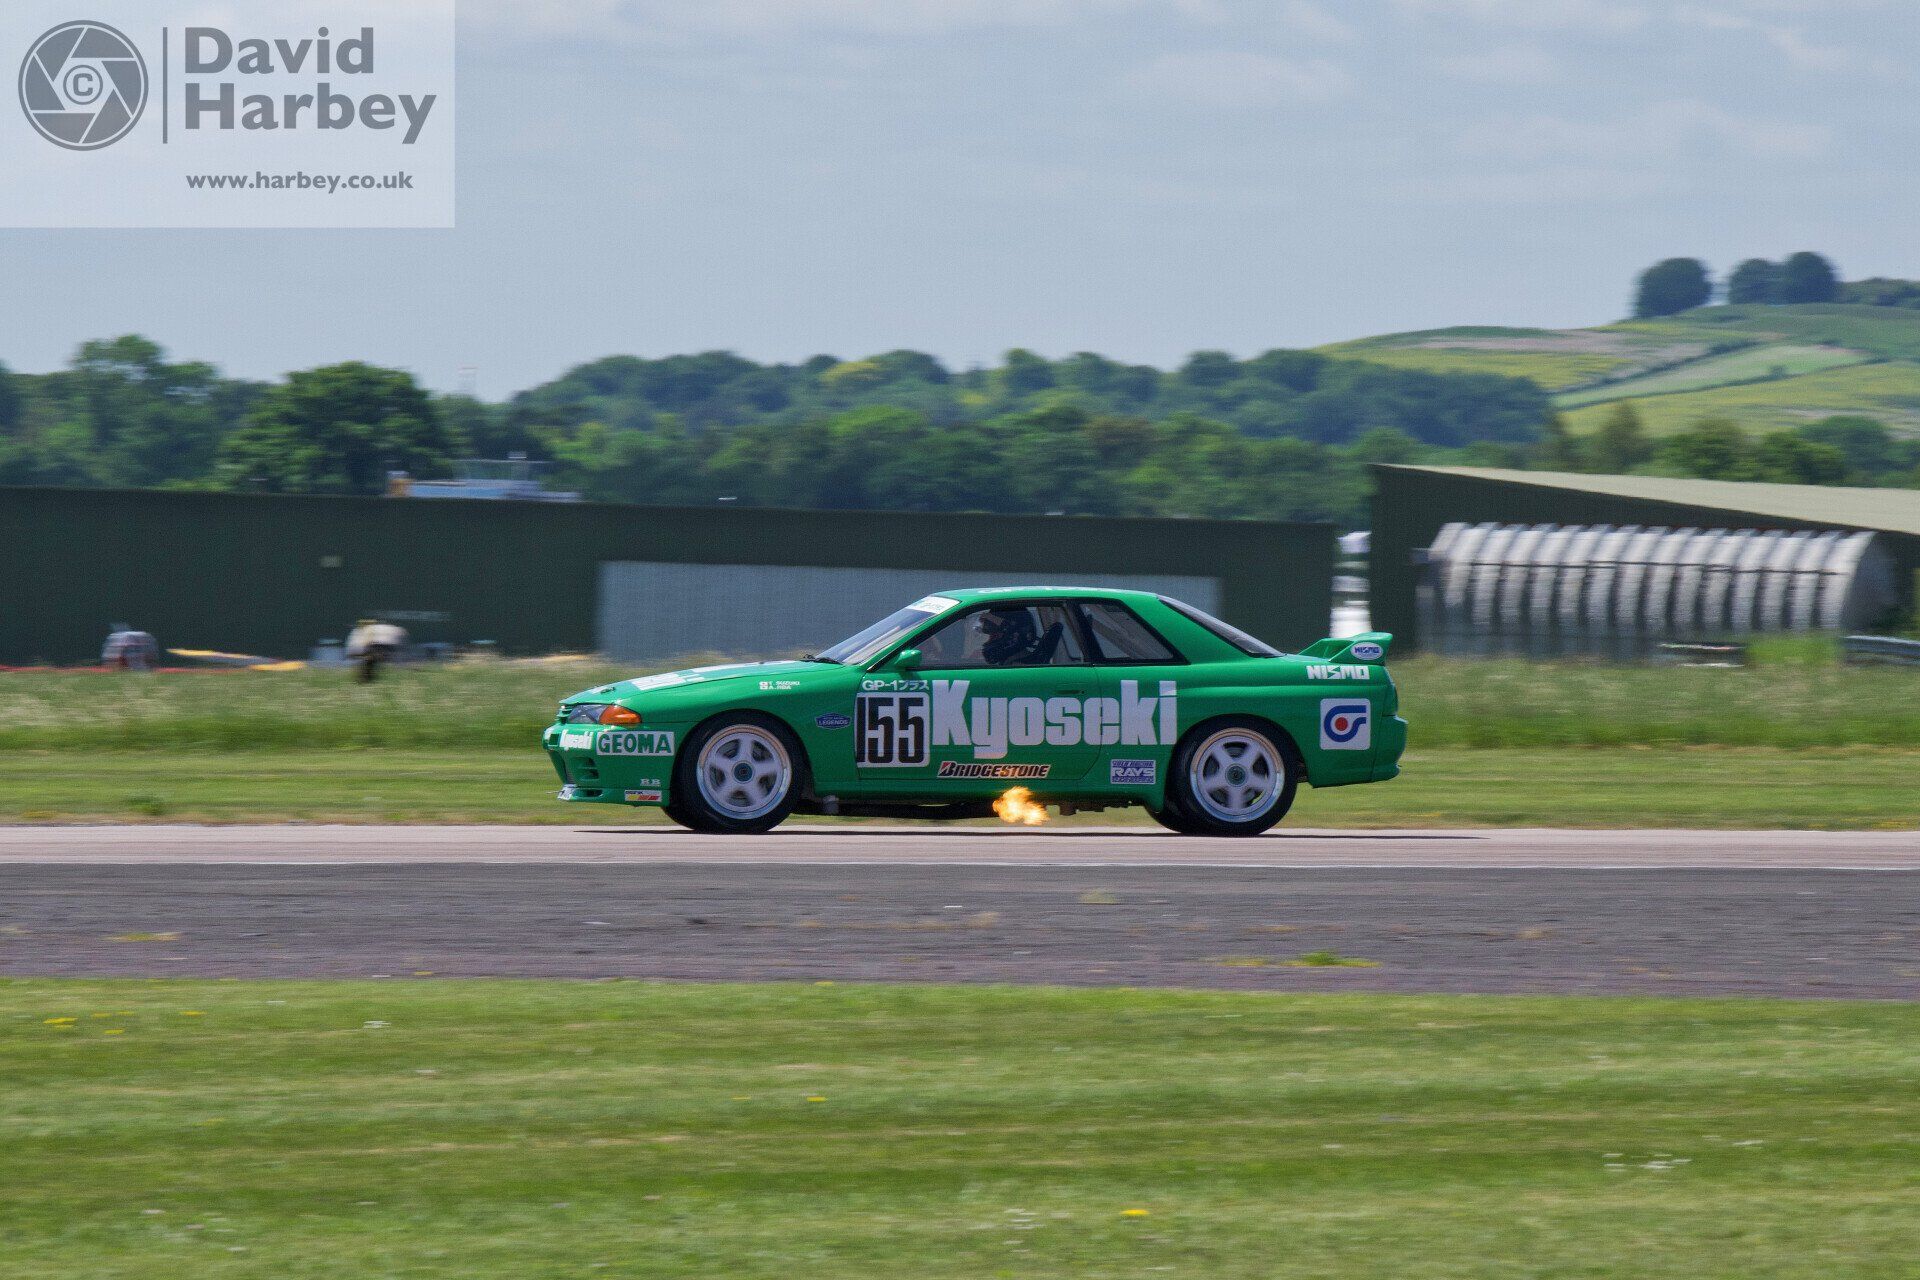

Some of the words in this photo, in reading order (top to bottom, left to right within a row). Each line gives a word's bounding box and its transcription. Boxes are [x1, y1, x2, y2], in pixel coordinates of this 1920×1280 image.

[1306, 665, 1370, 680] NISMO
[932, 679, 1177, 759] Kyoseki
[857, 697, 924, 763] 155
[598, 733, 672, 753] GEOMA
[938, 761, 1050, 777] BRIDGESTONE
[1112, 767, 1154, 777] RAYS
